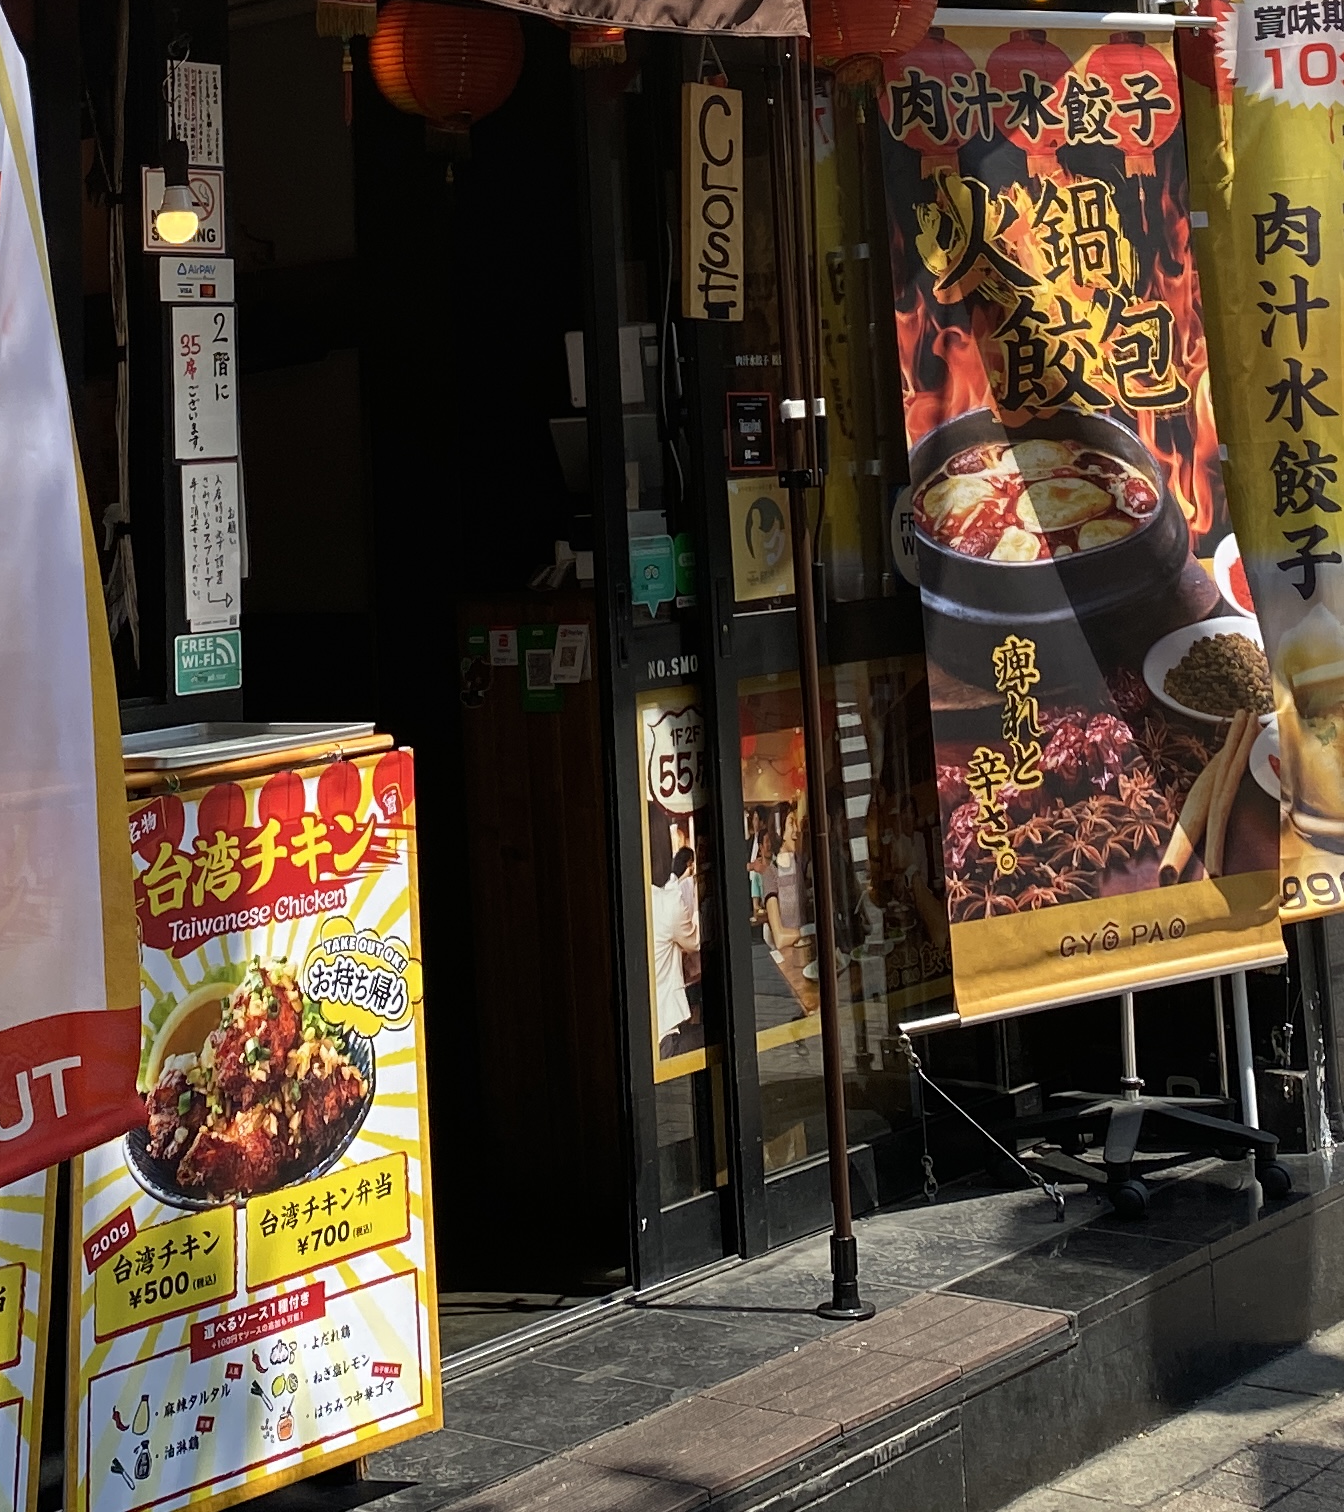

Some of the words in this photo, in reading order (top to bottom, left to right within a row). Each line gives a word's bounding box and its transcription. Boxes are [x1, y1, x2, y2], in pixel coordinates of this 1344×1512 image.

[888, 71, 1177, 148] 肉汁水餃子
[151, 226, 216, 244] SING
[932, 172, 1122, 294] 火鍋
[212, 312, 230, 402] 2階に
[992, 293, 1190, 414] 餃包
[1252, 191, 1343, 600] 肉汁水餃子
[181, 638, 214, 654] FREE
[992, 634, 1044, 790] 痺れと
[129, 811, 157, 844] 名物
[966, 747, 1017, 876] 辛さ。
[142, 813, 377, 917] 台湾チキン
[168, 904, 271, 943] Taiwanese
[273, 888, 347, 918] Chicken
[324, 937, 357, 956] TAKE
[358, 936, 384, 958] OUT
[384, 947, 408, 973] OK!
[311, 962, 404, 1016] お持ち帰り
[259, 1172, 393, 1239] 台湾チキン弁当
[90, 1222, 130, 1261] 200g
[112, 1230, 221, 1285] 台湾チキン
[203, 1292, 310, 1341] 選べるソース1種付き
[311, 1324, 351, 1351] よだれ鶏
[312, 1352, 371, 1385] ねぎ塩レモン
[162, 1383, 232, 1419] 麻辣タルタル
[314, 1378, 396, 1420] はちみつ中華ゴマ
